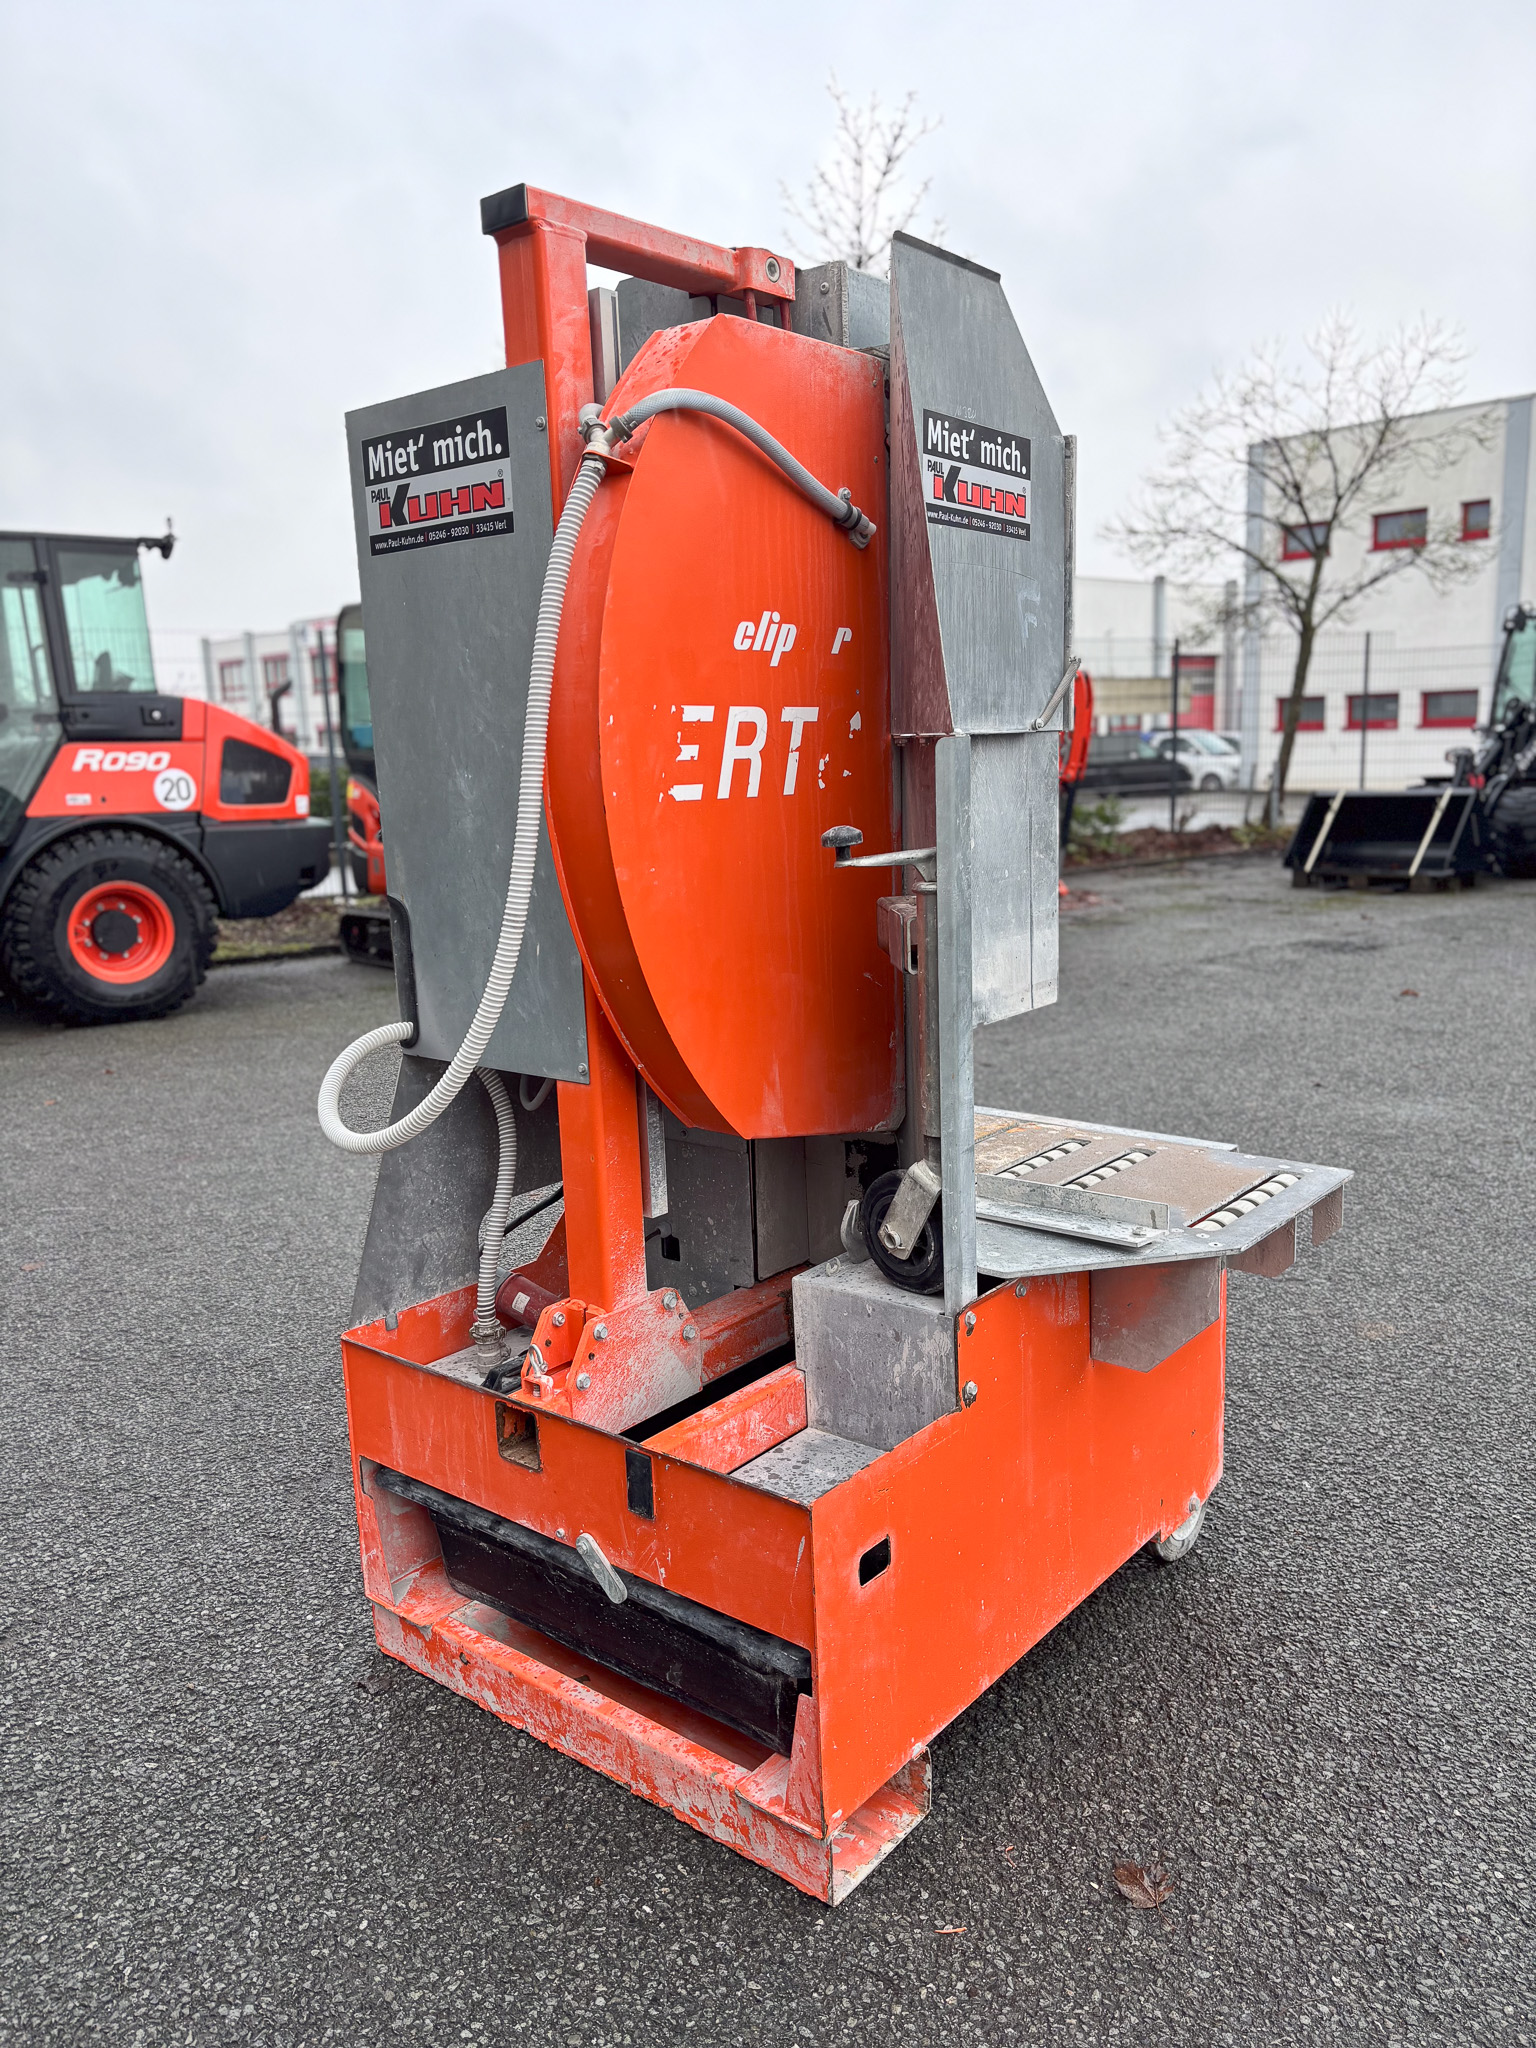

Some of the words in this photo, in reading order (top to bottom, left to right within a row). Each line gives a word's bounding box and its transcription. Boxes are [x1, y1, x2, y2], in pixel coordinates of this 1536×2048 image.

[433, 419, 502, 466] mich.
[980, 436, 1027, 475] mich.
[927, 459, 944, 475] PAUL
[371, 487, 390, 503] PAUL
[379, 478, 506, 529] KUHN
[933, 465, 1027, 519] KUHN
[375, 534, 424, 550] www.Paul-Kuhn.de
[428, 529, 446, 541] 05246
[451, 525, 470, 537] 92030
[476, 521, 494, 533] 33415
[494, 519, 507, 530] Verl
[660, 705, 862, 801] ERT
[161, 777, 191, 802] 20
